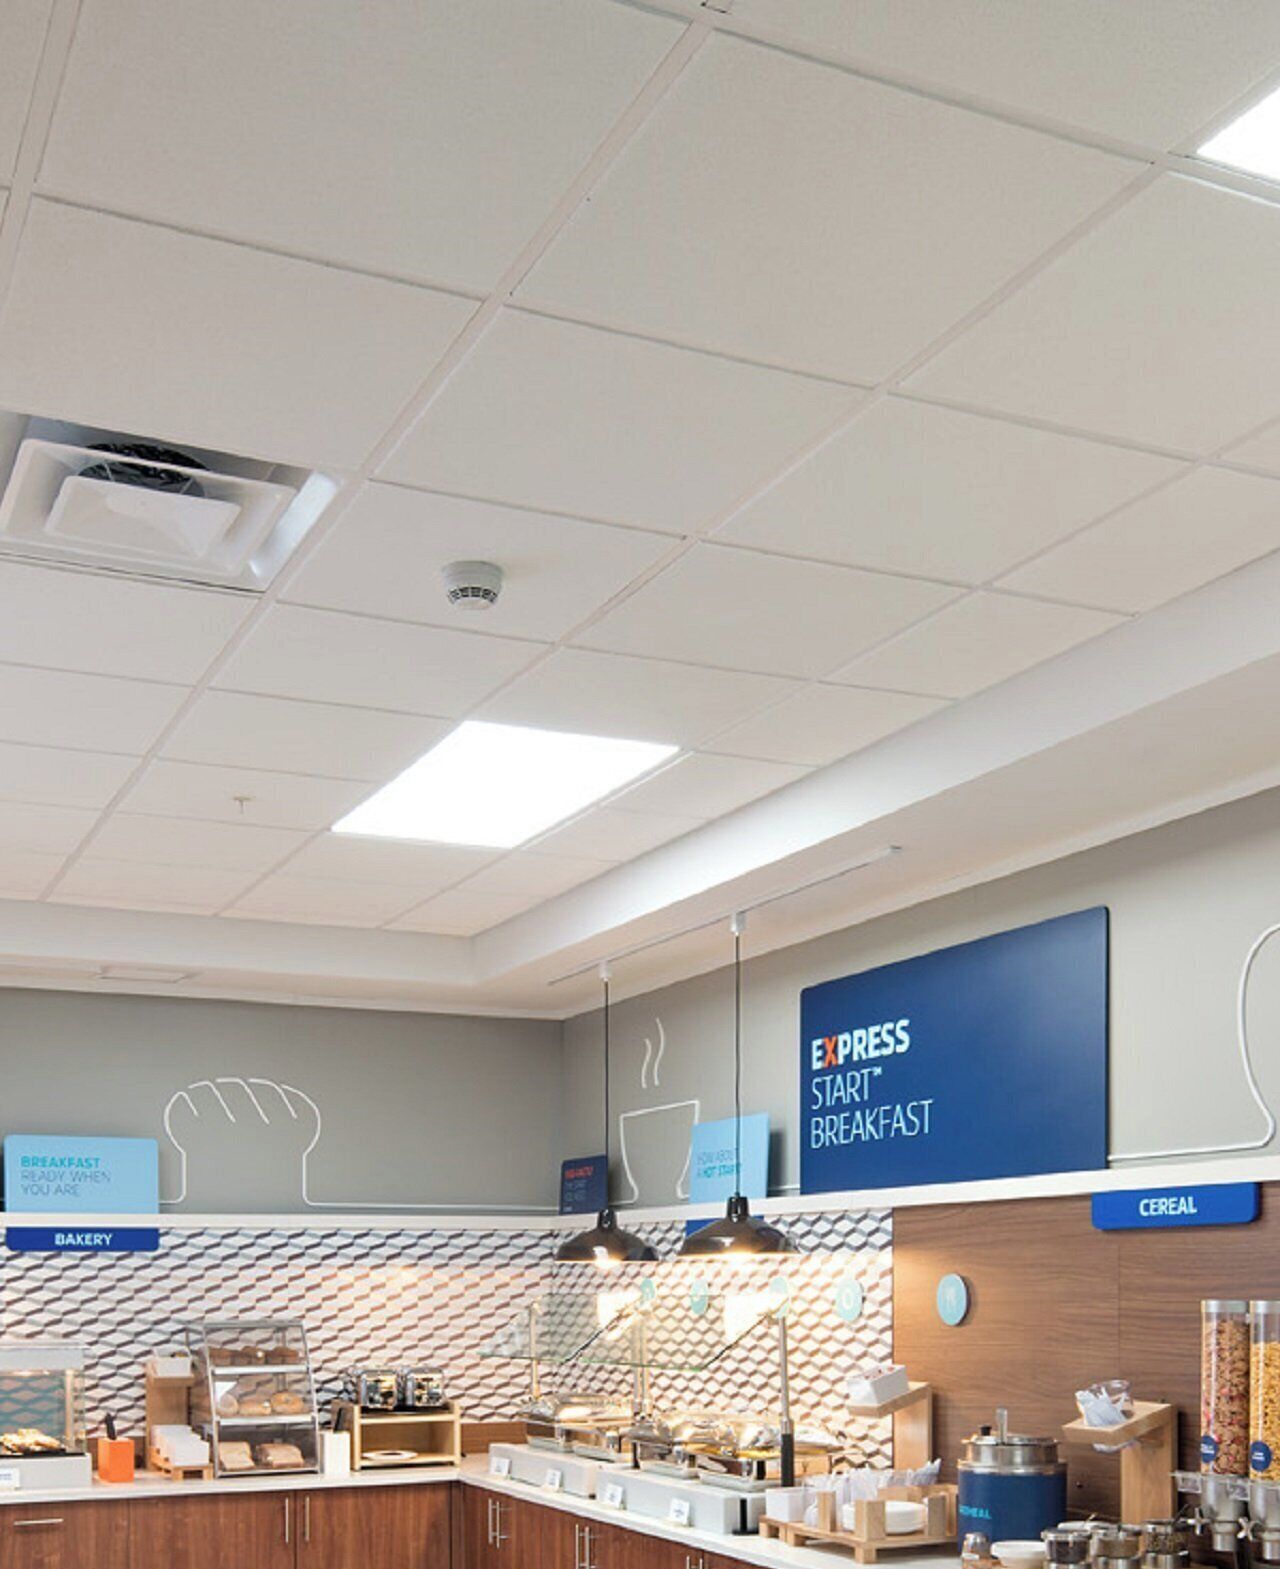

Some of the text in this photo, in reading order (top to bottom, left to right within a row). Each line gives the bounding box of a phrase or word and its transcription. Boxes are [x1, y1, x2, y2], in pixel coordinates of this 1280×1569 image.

[811, 1018, 910, 1071] EXPRESS
[810, 1098, 935, 1149] BREAKFAST
[20, 1155, 101, 1170] BREAKFAST
[20, 1169, 112, 1184] READY WHEN
[20, 1183, 81, 1197] YOU ARE
[1138, 1195, 1198, 1217] CEREAL
[53, 1232, 114, 1247] BAKERY
